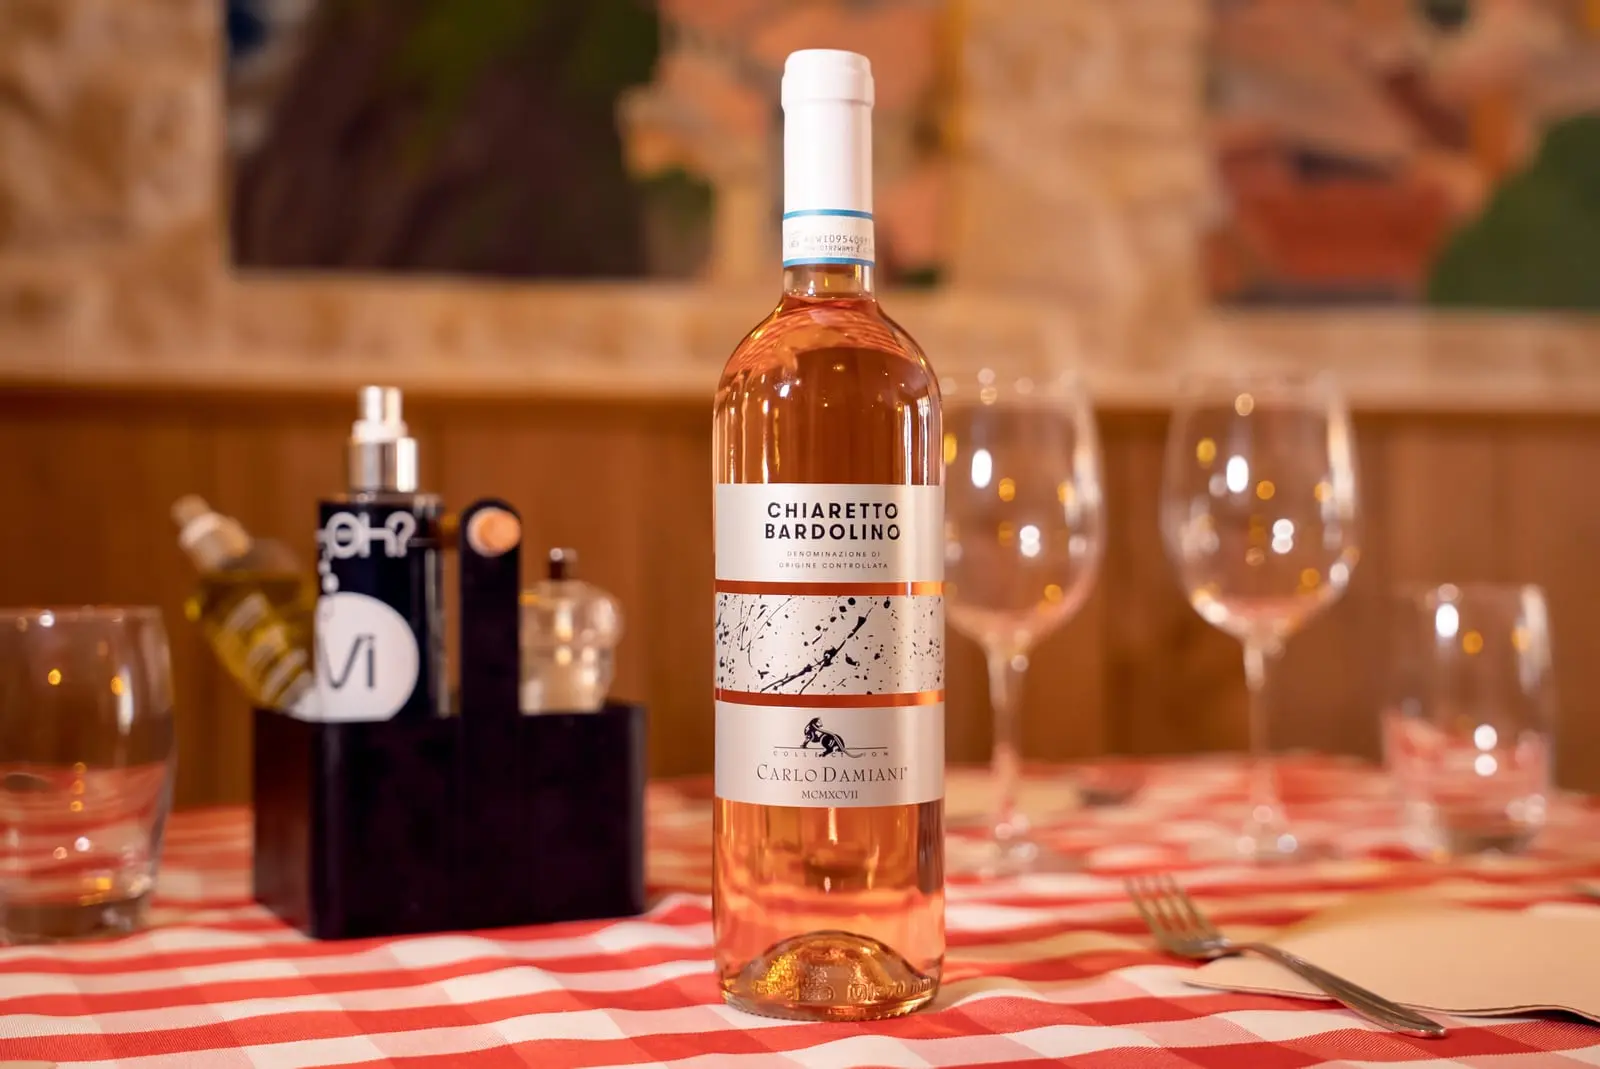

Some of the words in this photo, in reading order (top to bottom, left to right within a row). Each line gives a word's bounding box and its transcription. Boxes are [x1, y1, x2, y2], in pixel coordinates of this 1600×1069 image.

[767, 502, 898, 519] CHIARETTO
[765, 523, 900, 541] BARDOLINO
[822, 562, 888, 570] CONTROLLATA
[801, 790, 859, 800] MCMXCVII
